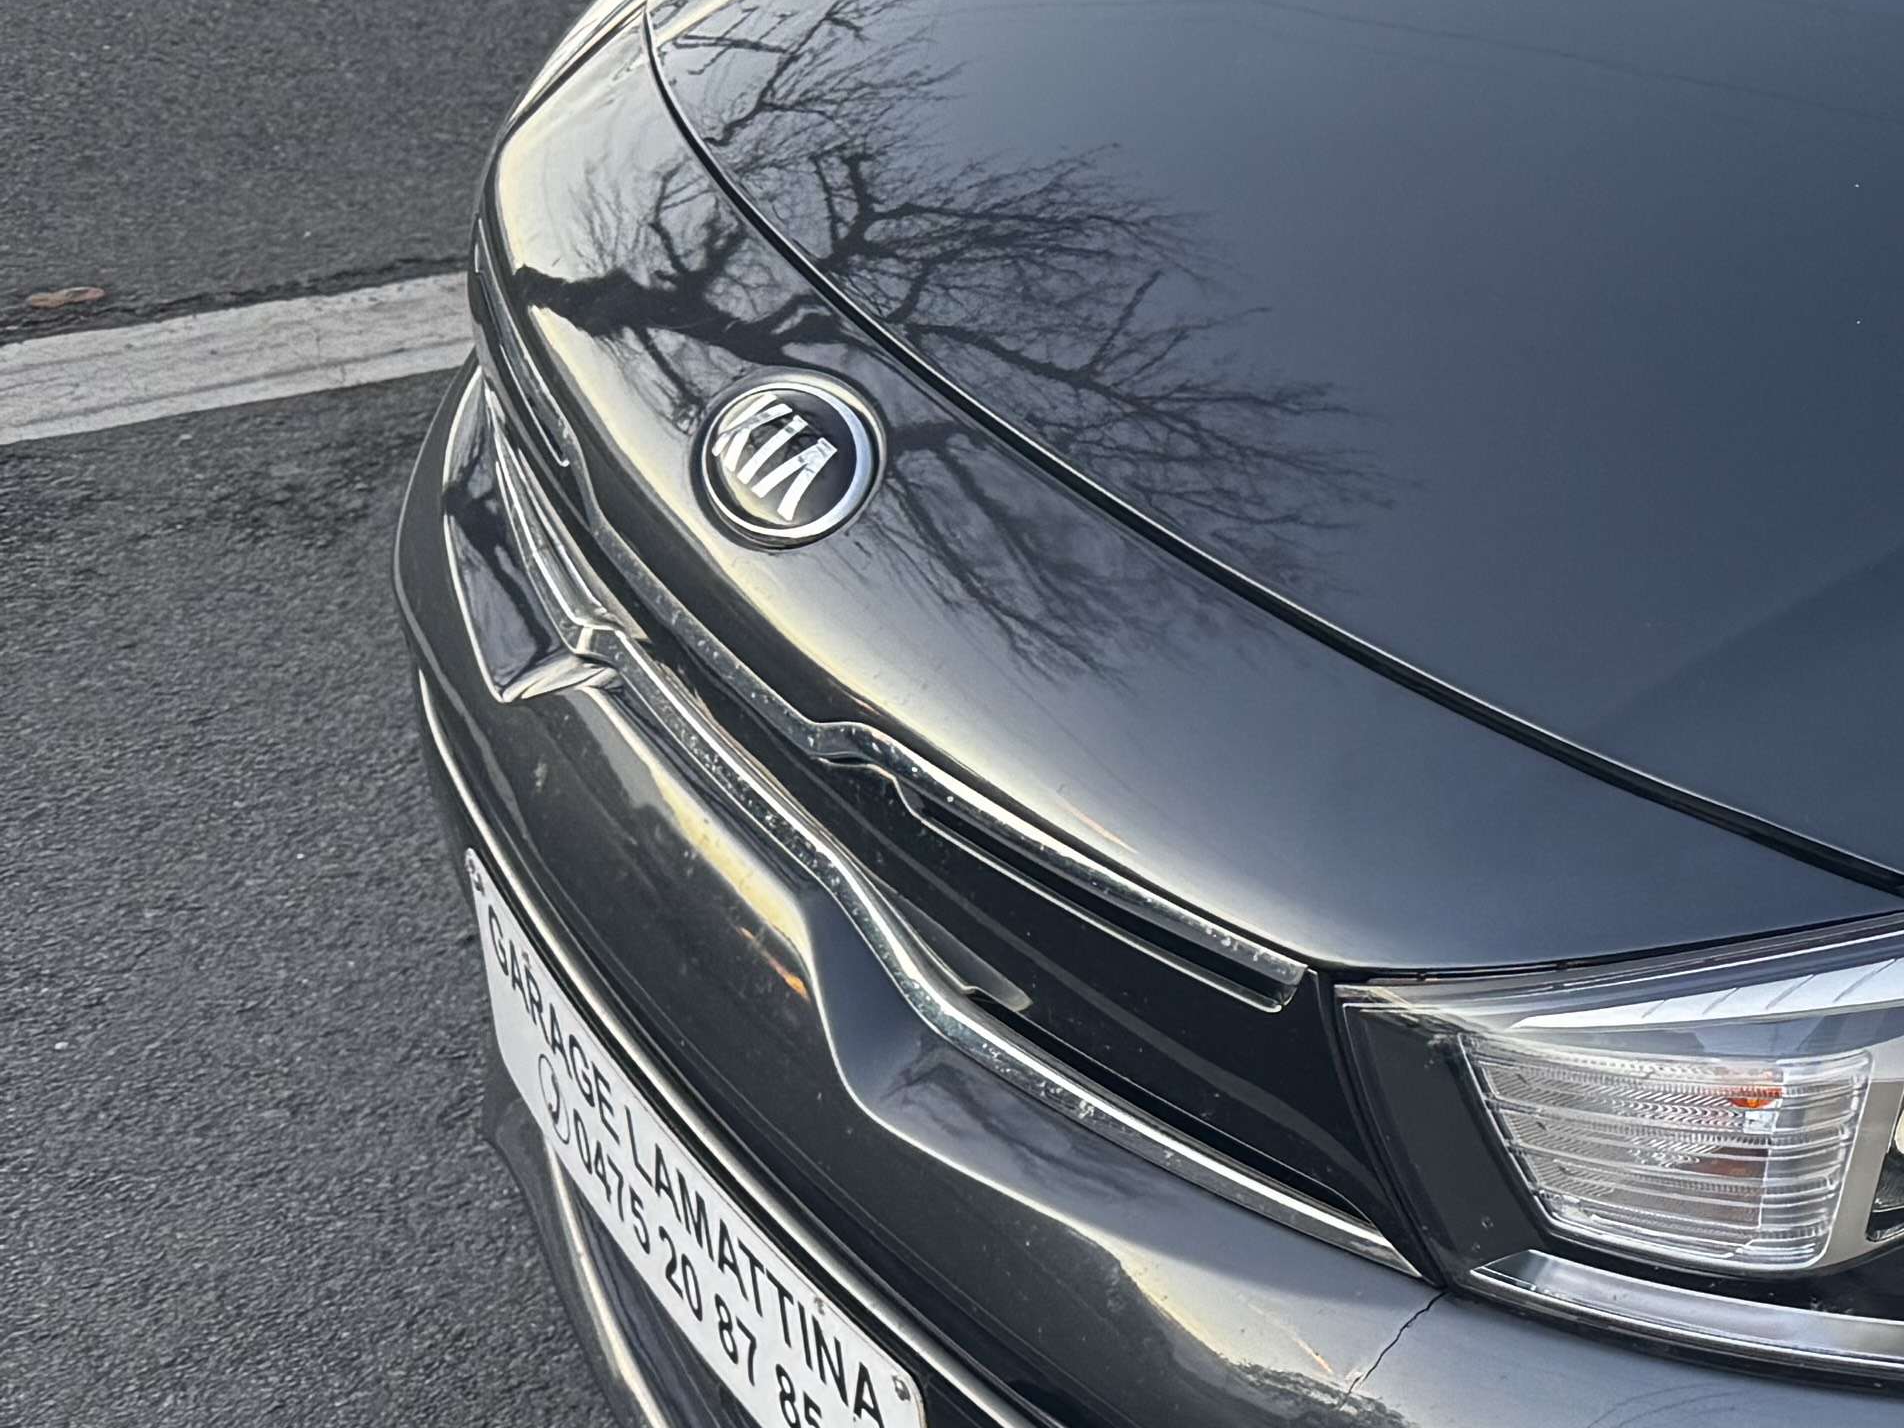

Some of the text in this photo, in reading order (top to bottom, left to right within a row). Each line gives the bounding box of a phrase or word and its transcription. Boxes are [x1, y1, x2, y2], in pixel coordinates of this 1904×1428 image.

[711, 392, 838, 521] KIA
[488, 905, 621, 1145] GARAGE
[573, 1108, 650, 1254] 0475
[659, 1226, 703, 1322] 20
[715, 1293, 757, 1387] 87
